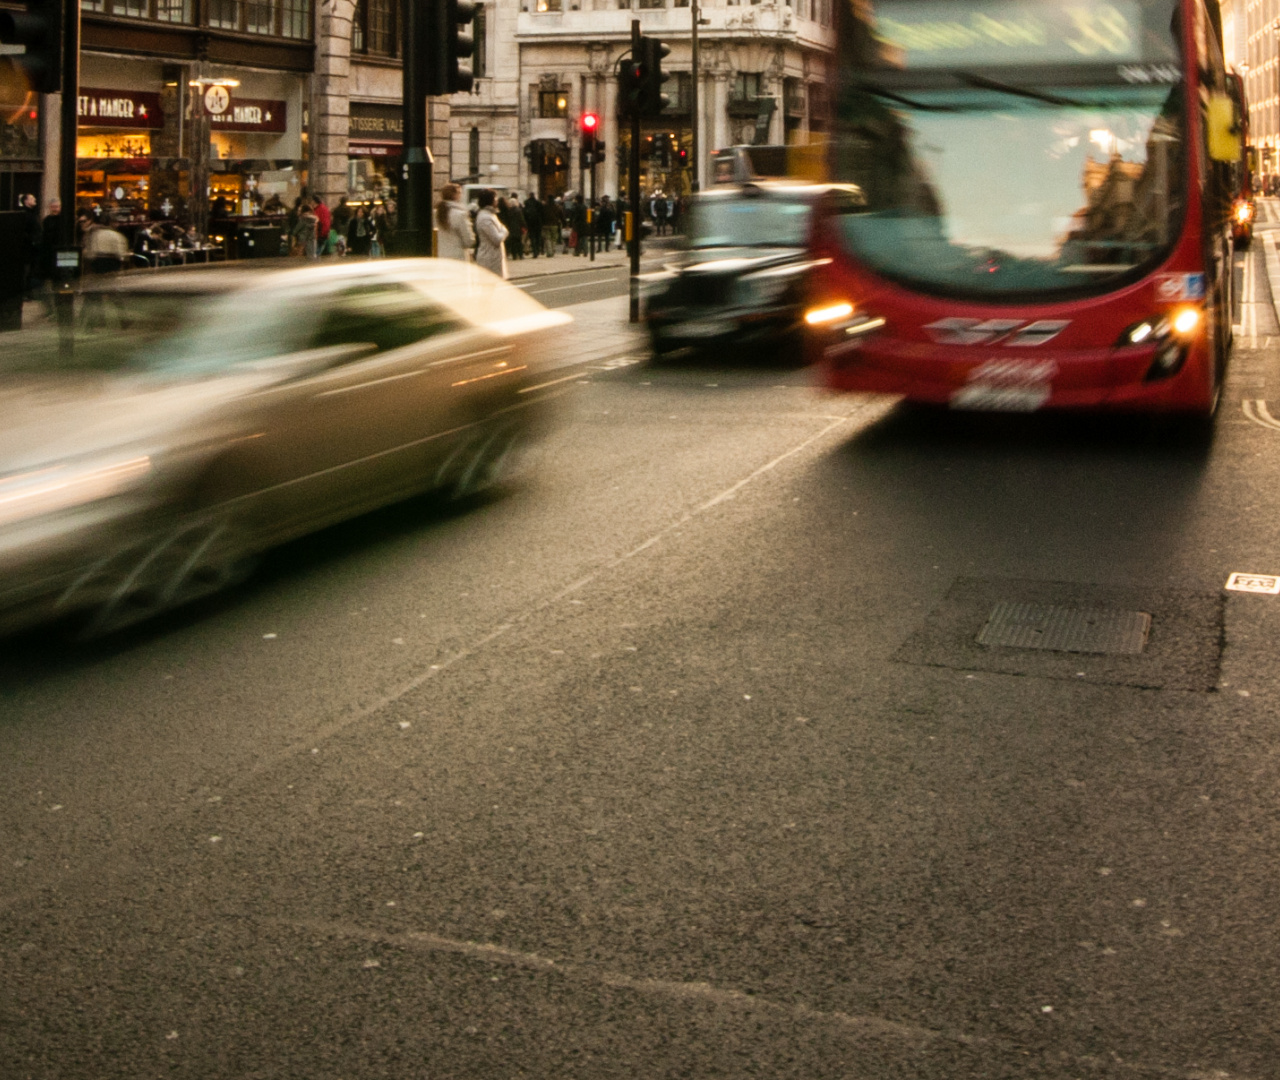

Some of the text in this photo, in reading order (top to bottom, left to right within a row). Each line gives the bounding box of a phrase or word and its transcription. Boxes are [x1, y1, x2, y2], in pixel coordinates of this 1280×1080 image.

[77, 96, 88, 116] ET
[99, 98, 134, 118] MANGER
[349, 117, 403, 133] ATISSERIE VALE
